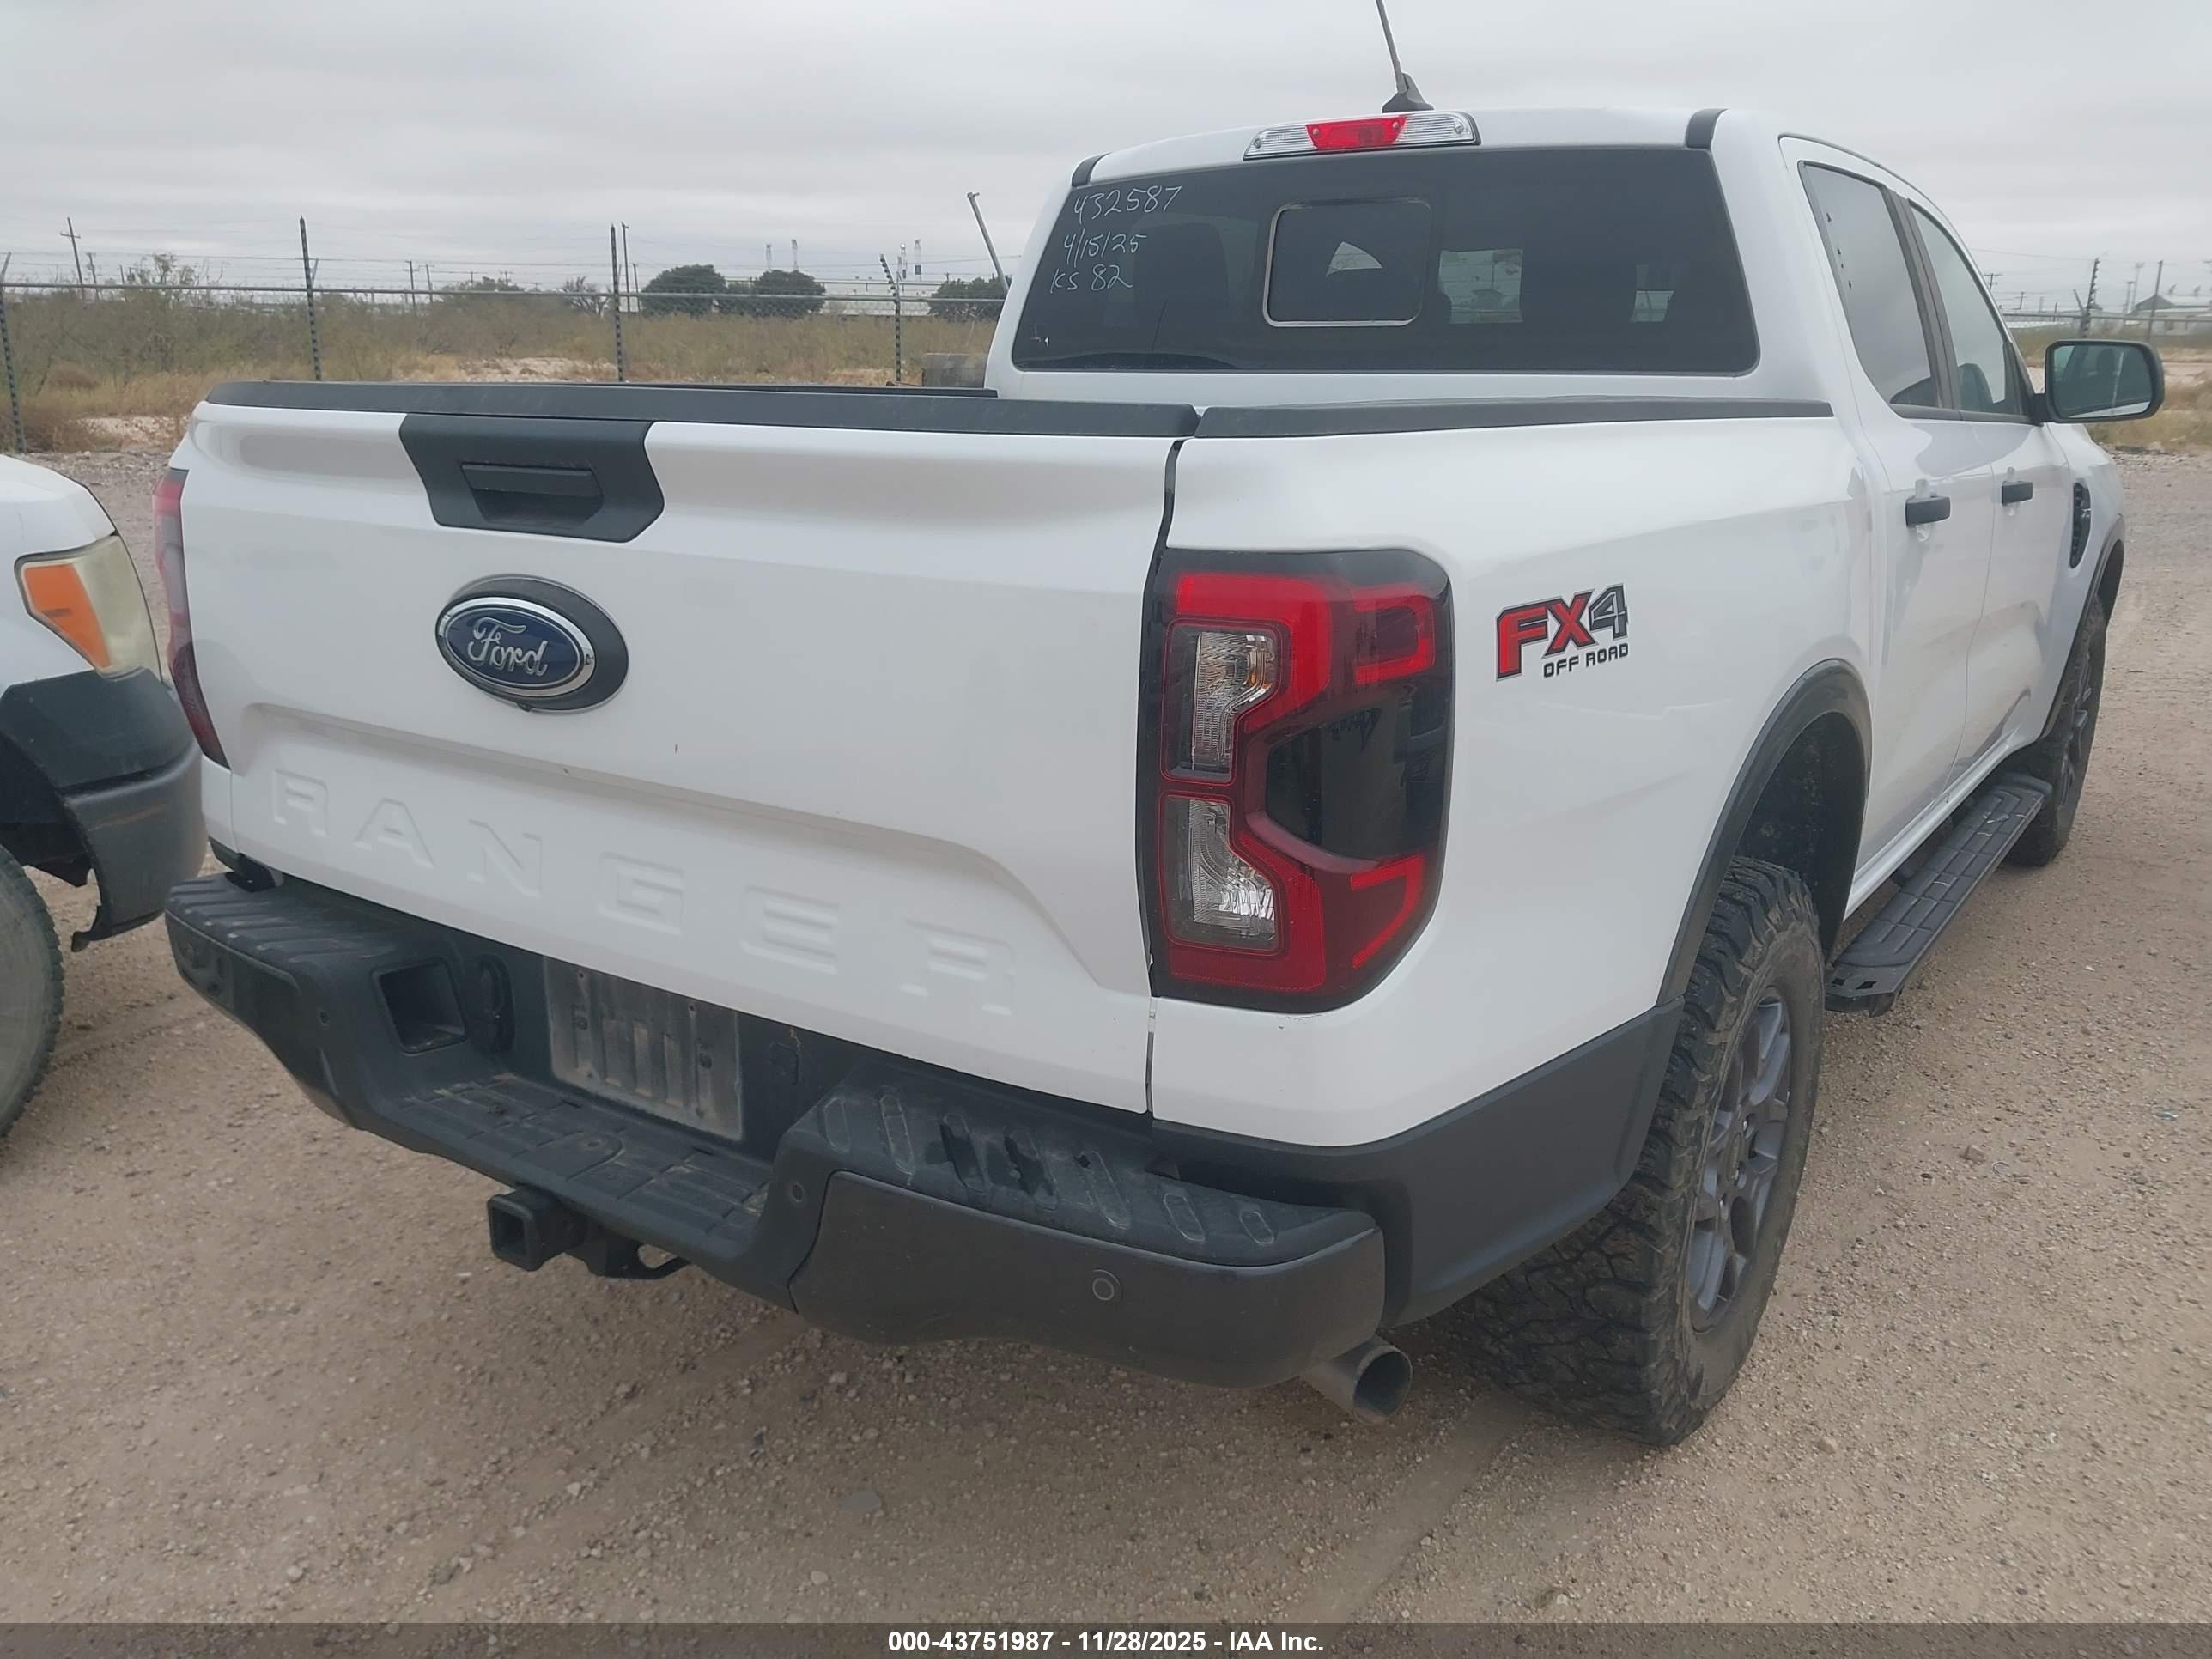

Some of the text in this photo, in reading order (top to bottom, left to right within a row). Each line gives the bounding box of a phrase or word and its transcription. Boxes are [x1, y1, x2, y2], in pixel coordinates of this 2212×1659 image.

[1074, 185, 1182, 225] 432587
[1064, 228, 1148, 268] 4/15/25
[1091, 264, 1133, 291] 82
[467, 617, 548, 677] Ford
[1496, 583, 1629, 681] FX4
[1543, 642, 1629, 678] OFF ROAD
[271, 768, 1015, 1017] RANGER
